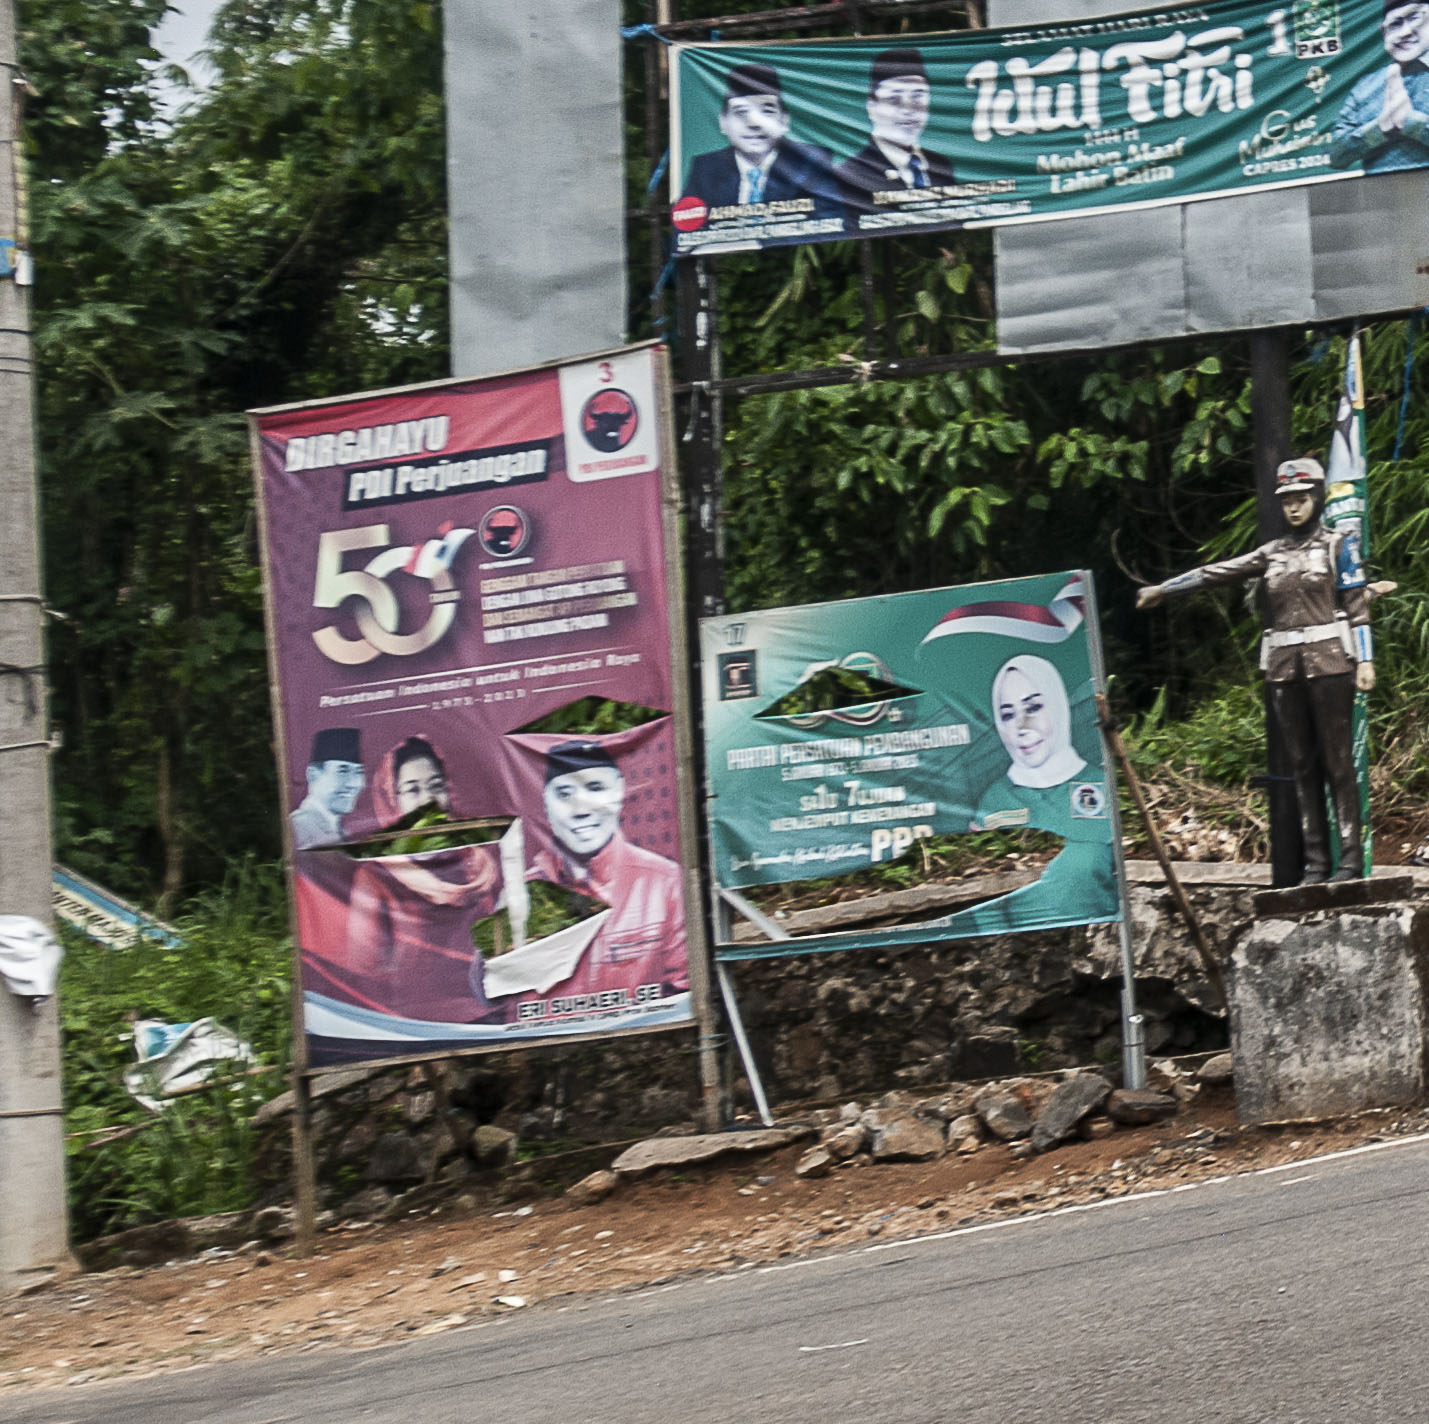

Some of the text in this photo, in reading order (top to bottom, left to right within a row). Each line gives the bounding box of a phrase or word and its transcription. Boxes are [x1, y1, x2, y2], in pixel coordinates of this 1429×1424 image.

[1265, 8, 1292, 57] 1
[1296, 40, 1339, 57] PKB
[966, 26, 1255, 142] Idul Fitri
[1036, 136, 1188, 174] Mohon Maaf
[1242, 157, 1297, 176] CAPRES
[597, 362, 615, 383] 3
[286, 415, 450, 472] DIRGAHAYU
[347, 469, 393, 503] PDI
[394, 449, 547, 495] Perjuangan
[518, 1000, 548, 1020] ERI
[635, 983, 662, 1002] SE
